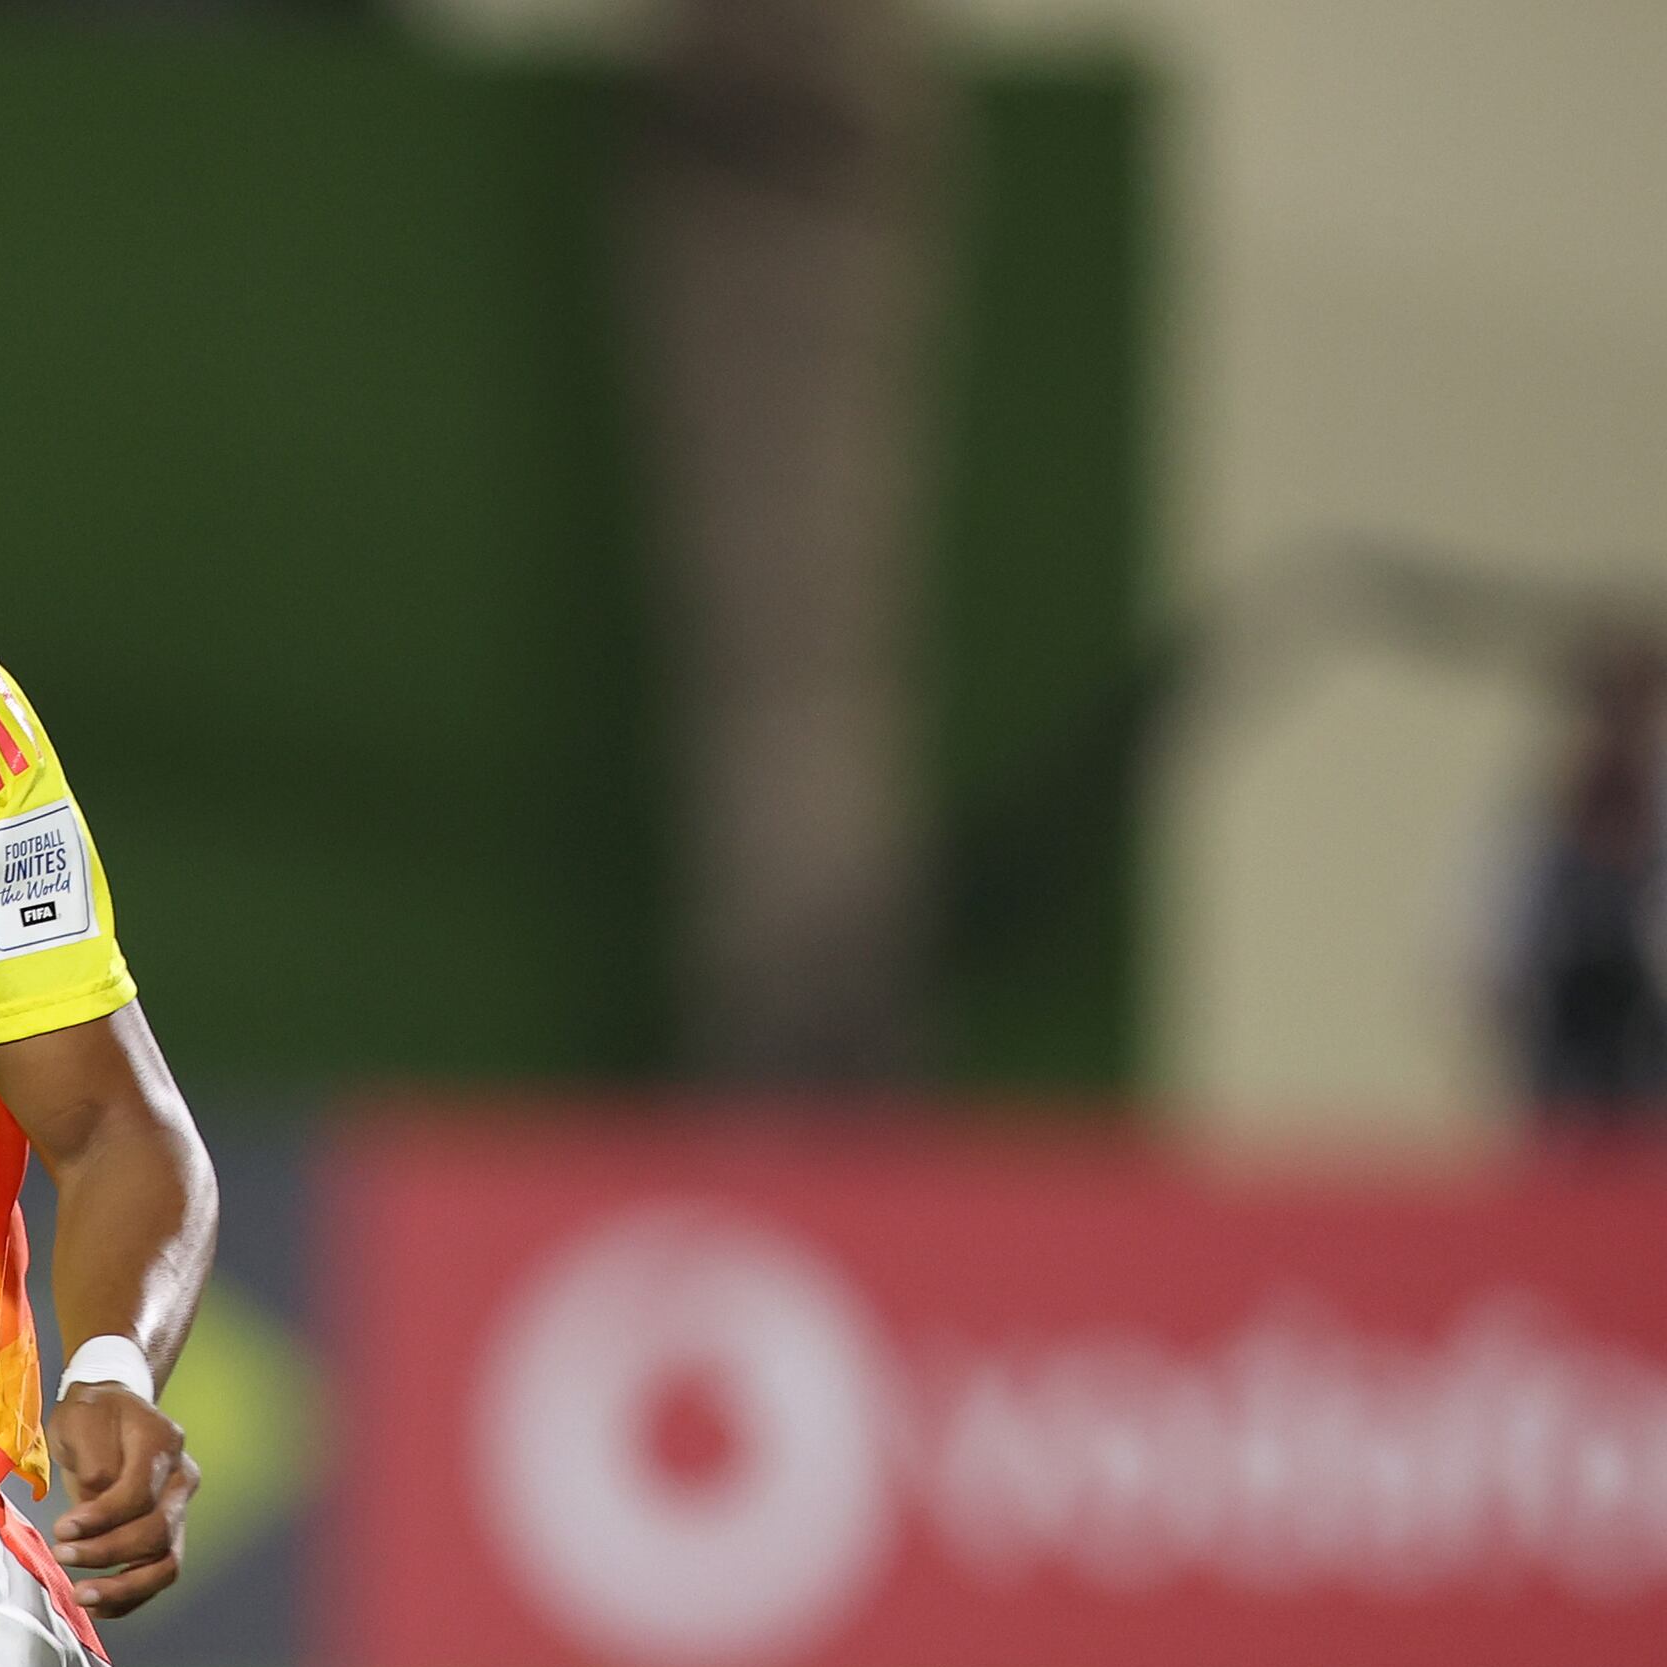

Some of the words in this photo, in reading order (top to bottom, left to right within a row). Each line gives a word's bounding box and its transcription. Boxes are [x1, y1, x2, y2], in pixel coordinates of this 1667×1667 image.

[5, 828, 65, 862] FOOTBALL
[4, 848, 67, 884] UNITES
[27, 871, 71, 900] World
[23, 905, 54, 923] FIFA
